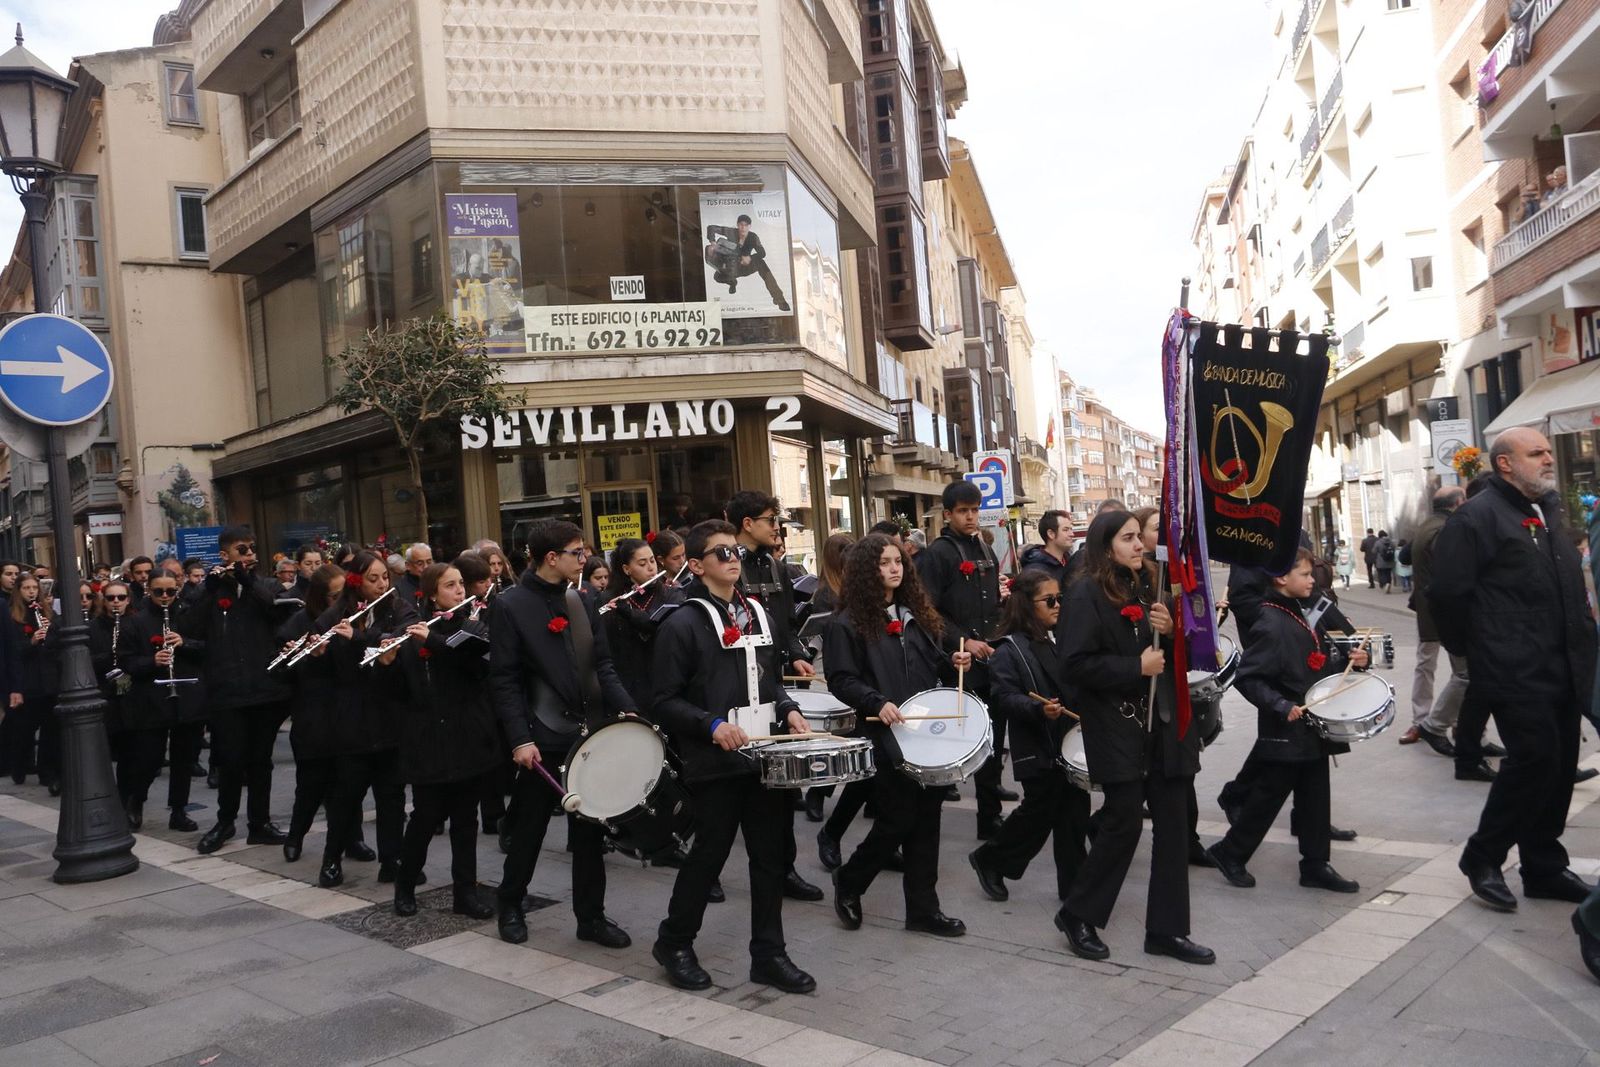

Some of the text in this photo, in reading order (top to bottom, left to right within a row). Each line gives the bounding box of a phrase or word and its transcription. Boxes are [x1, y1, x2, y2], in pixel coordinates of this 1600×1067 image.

[719, 198, 741, 206] FIESTAS
[741, 198, 754, 206] CON
[452, 203, 507, 218] Música
[757, 210, 782, 218] VITALY
[469, 214, 513, 229] Pasión
[611, 279, 645, 296] VENDO
[551, 313, 579, 327] ESTE
[582, 311, 631, 325] EDIFICIO
[651, 310, 706, 326] PLANTAS)
[527, 327, 721, 351] Tfn.: 692 16 92 92
[459, 395, 803, 450] SEVILLANO 2
[607, 515, 631, 524] VENDO
[1222, 525, 1270, 548] ZAMORA
